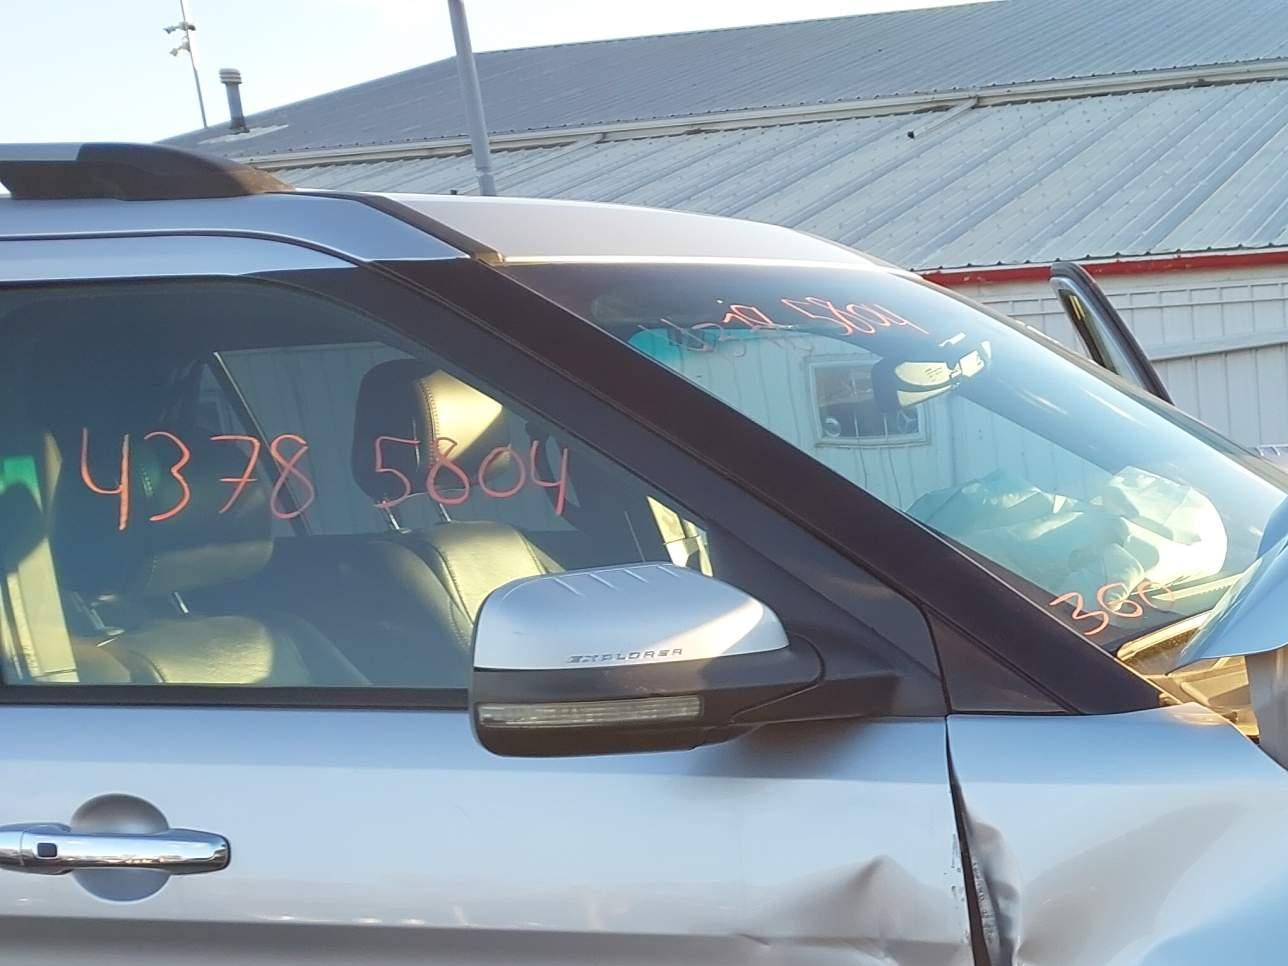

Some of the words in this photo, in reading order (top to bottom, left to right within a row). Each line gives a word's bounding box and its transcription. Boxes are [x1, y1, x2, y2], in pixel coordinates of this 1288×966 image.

[80, 426, 318, 531] 4378
[373, 434, 570, 516] 5804
[568, 648, 684, 664] EXPLORER
